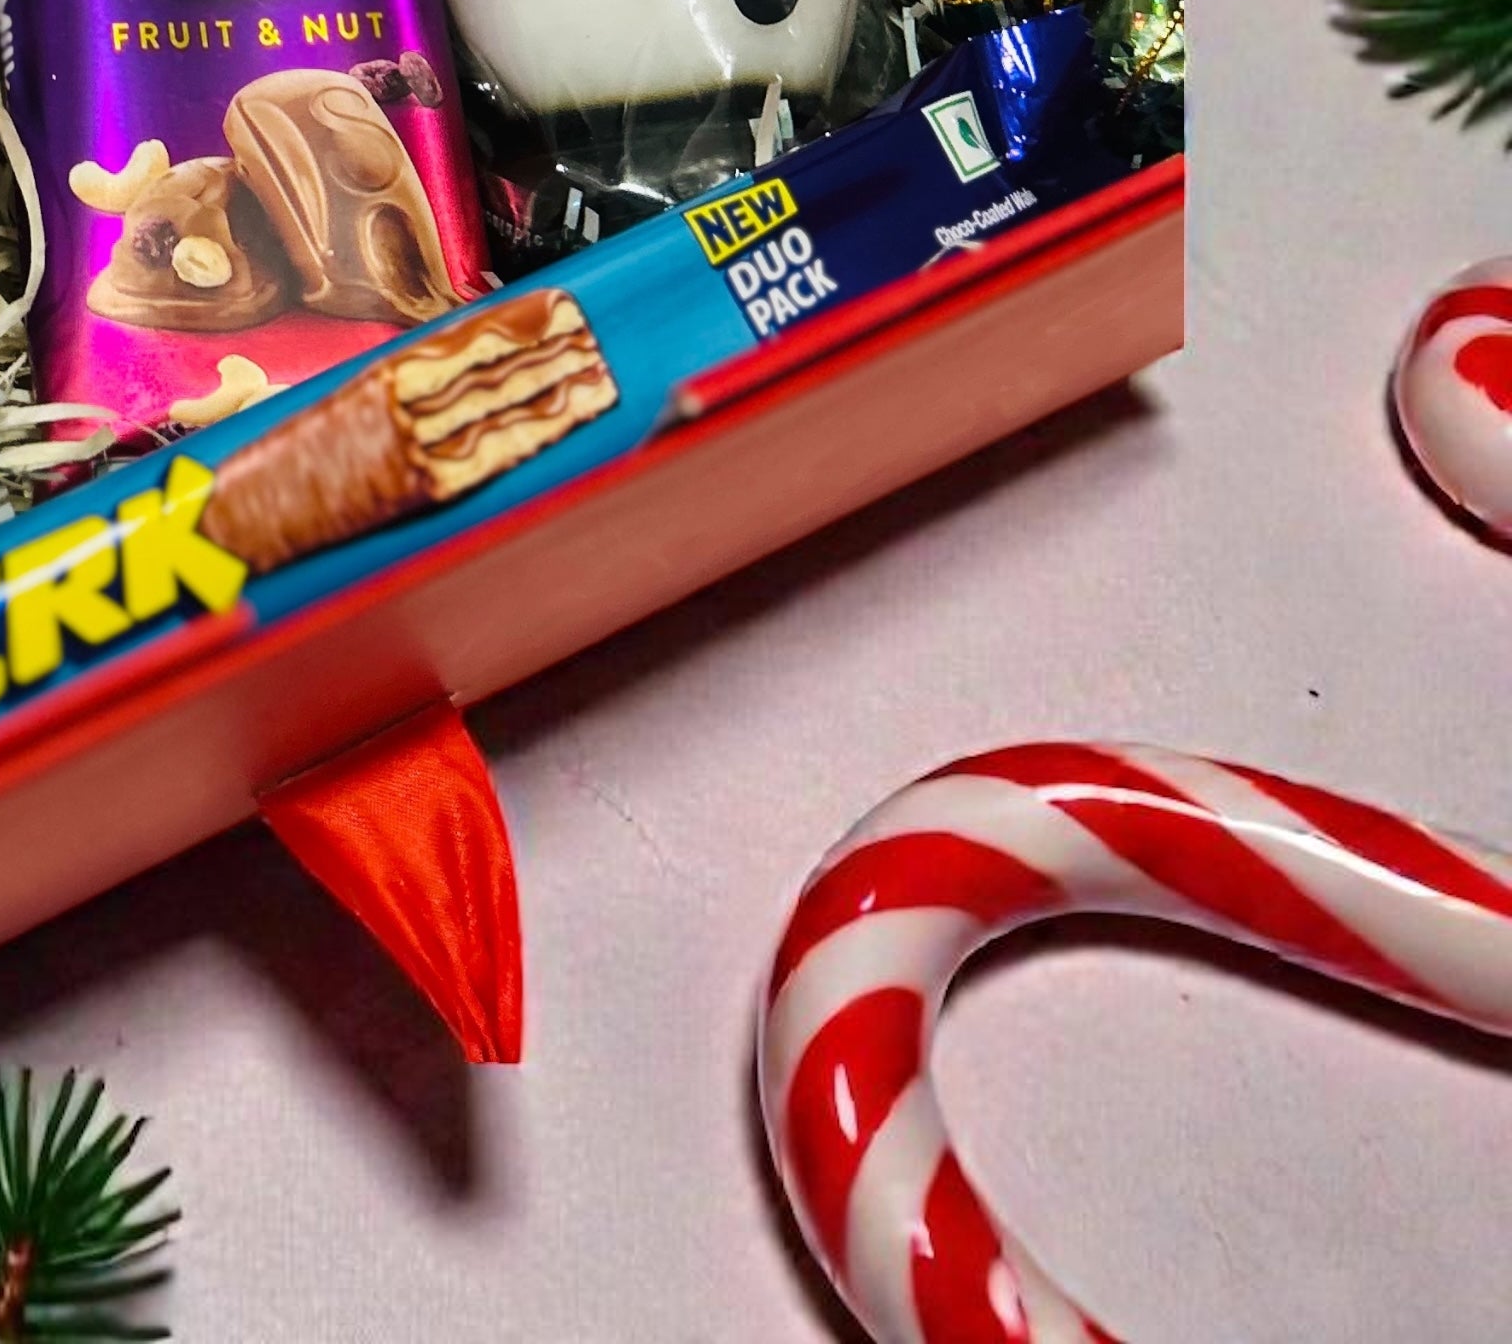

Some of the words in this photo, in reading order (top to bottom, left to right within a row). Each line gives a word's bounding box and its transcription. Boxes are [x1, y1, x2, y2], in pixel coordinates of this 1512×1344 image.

[111, 20, 233, 51] FRUIT
[257, 17, 283, 47] &
[302, 11, 384, 45] NUT
[692, 184, 787, 257] NEW
[727, 226, 812, 292] DUO
[745, 258, 839, 336] PACK
